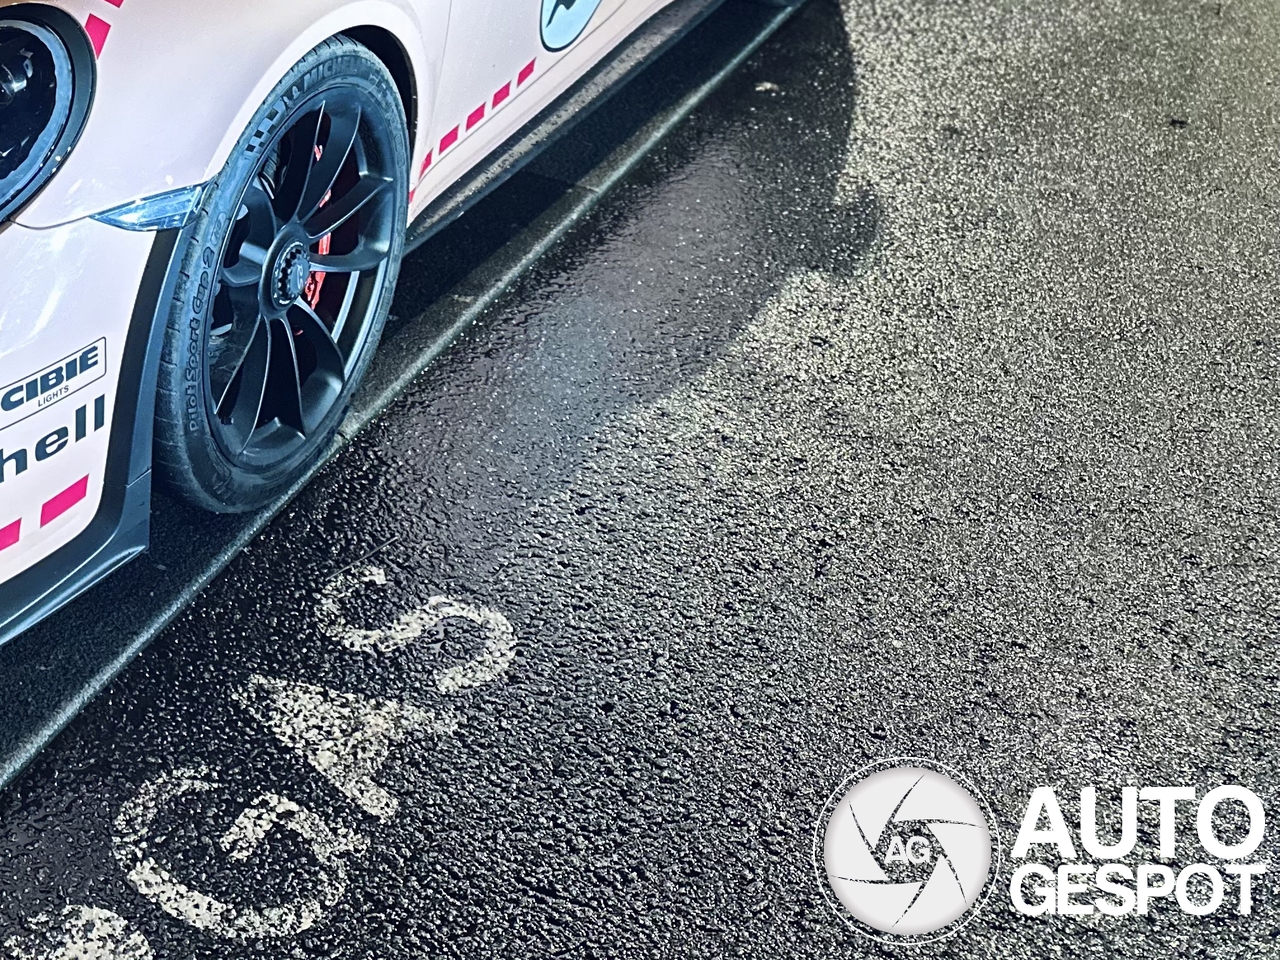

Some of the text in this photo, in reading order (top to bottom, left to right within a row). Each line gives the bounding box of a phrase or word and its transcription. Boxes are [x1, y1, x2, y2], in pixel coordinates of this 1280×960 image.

[185, 246, 216, 433] Pilot Sport Cup 2
[37, 384, 70, 408] LIGHTS
